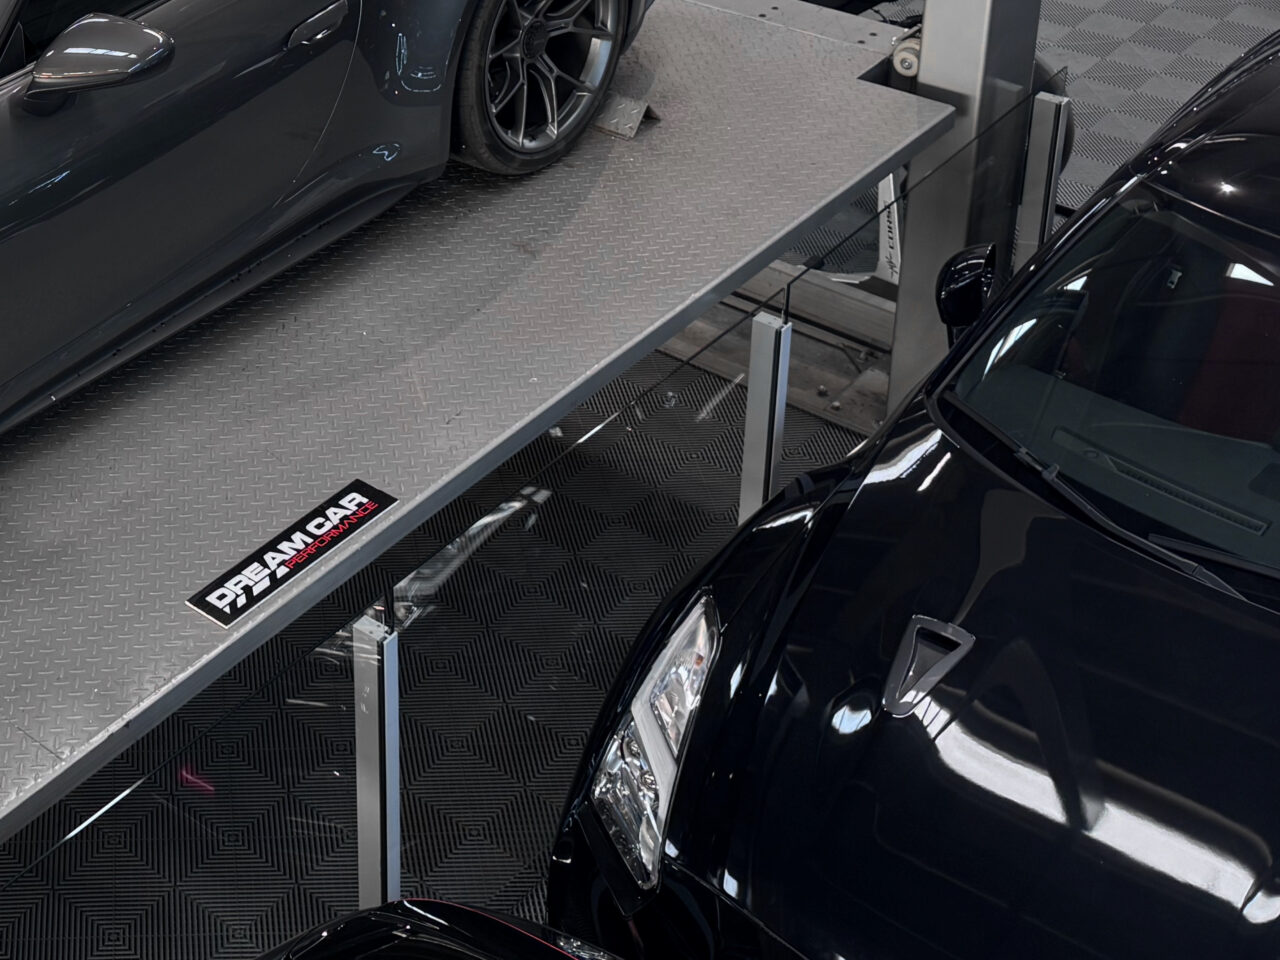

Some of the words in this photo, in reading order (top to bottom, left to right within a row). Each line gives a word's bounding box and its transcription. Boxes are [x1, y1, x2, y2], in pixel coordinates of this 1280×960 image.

[205, 530, 314, 614] DREAM
[305, 492, 370, 536] CAR
[286, 500, 379, 569] PERFORMANCE
